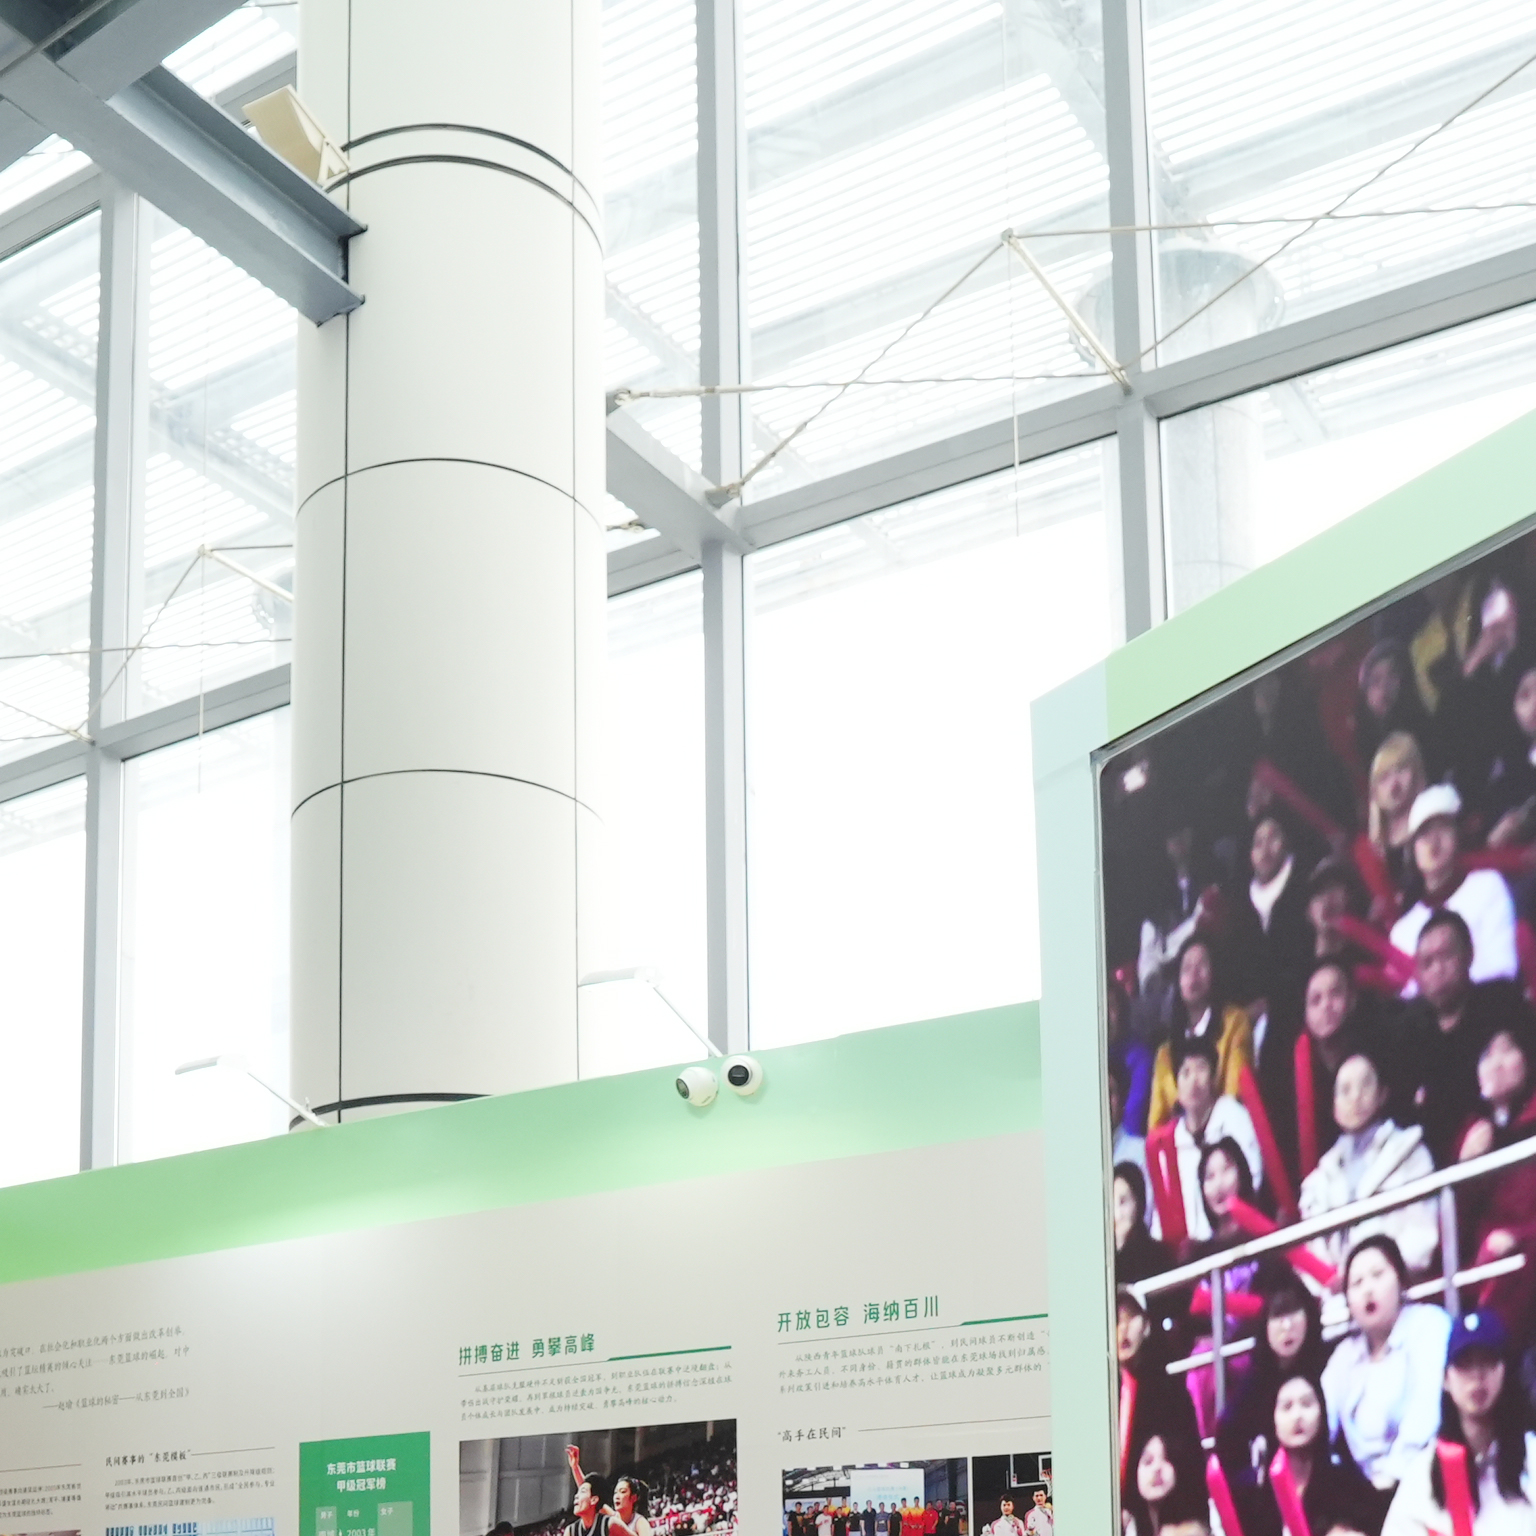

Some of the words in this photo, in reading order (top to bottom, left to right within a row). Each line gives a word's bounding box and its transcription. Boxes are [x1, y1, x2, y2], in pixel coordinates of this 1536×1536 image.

[777, 1305, 850, 1333] 开放包容
[863, 1295, 939, 1324] 海纳百川
[458, 1341, 520, 1366] 拼搏奋进
[531, 1333, 595, 1359] 勇攀高峰
[777, 1426, 846, 1443] “高手在民间”
[327, 1458, 396, 1475] 东莞市篮球联赛
[337, 1477, 386, 1492] 甲级冠军榜
